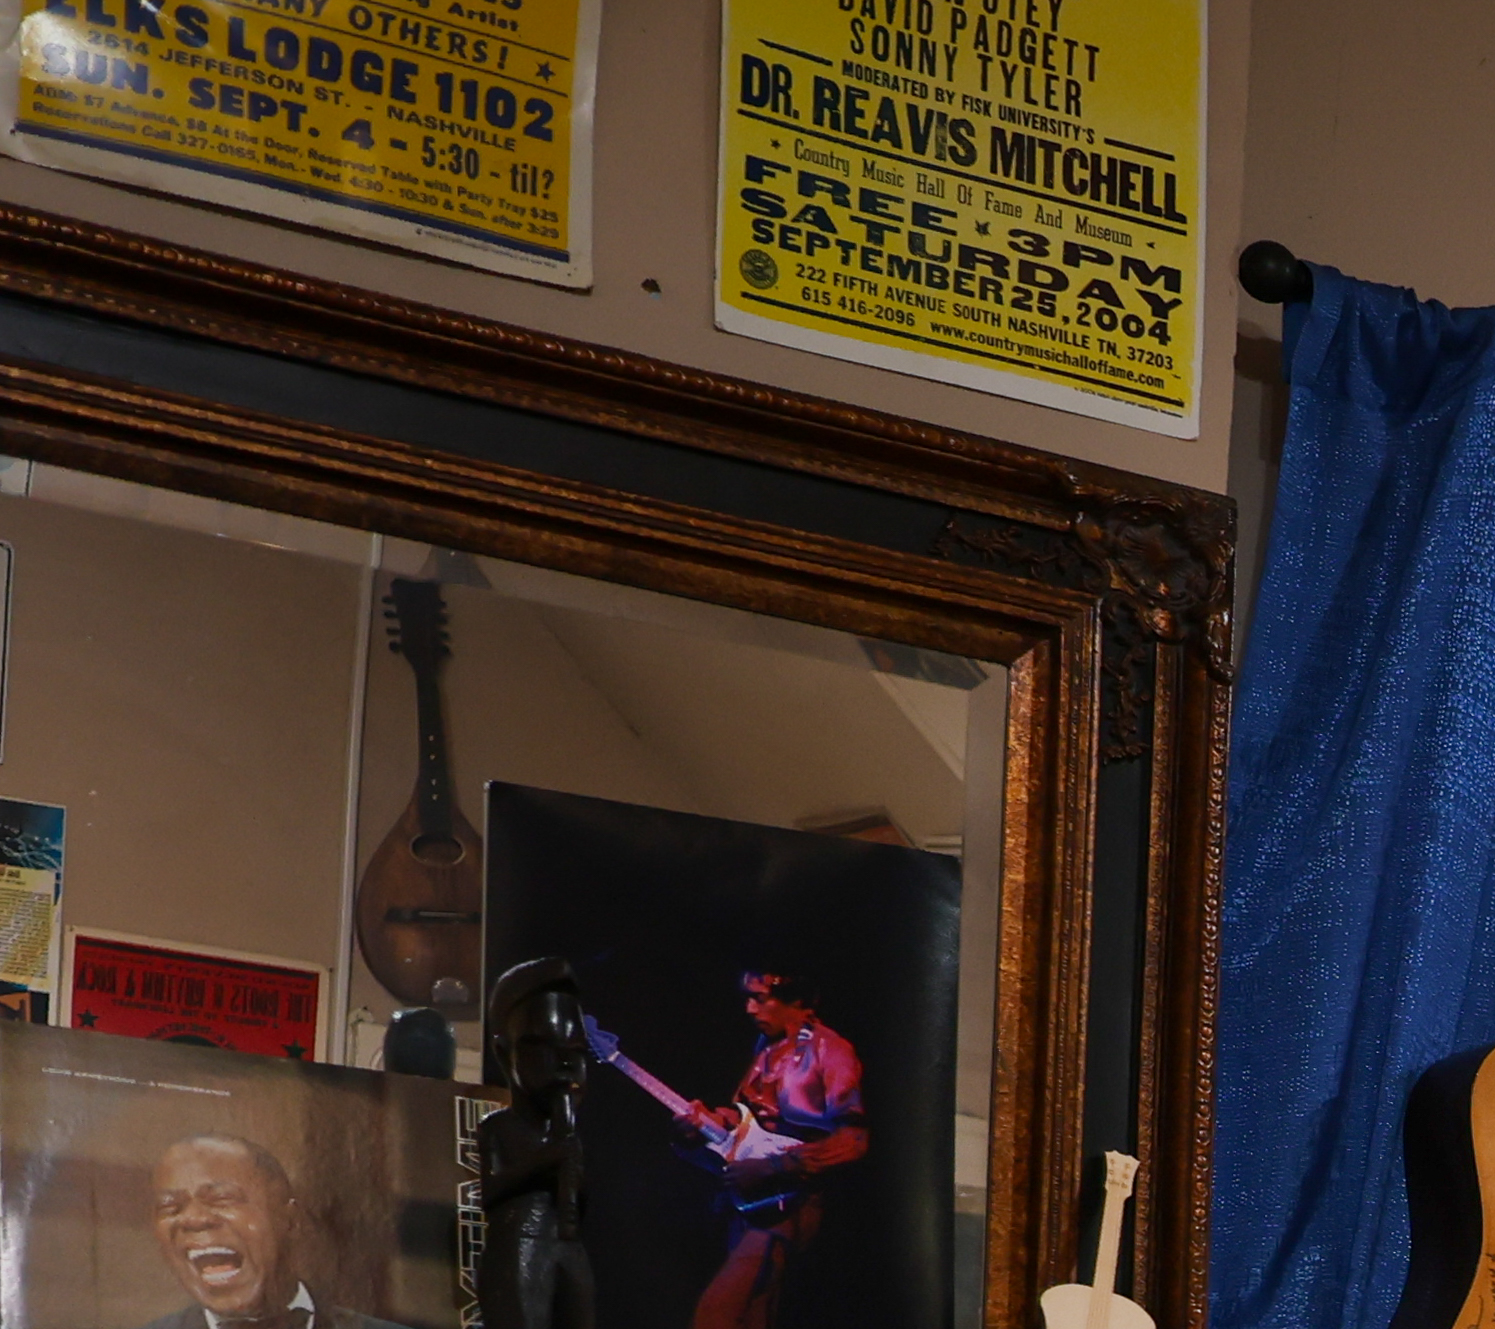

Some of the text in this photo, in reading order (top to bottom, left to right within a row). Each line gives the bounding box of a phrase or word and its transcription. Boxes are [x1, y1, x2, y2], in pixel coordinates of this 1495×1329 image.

[348, 5, 509, 71] OTHERS!
[448, 4, 519, 32] Artist
[849, 16, 1083, 118] SONNY TYLER
[950, 7, 1101, 82] PADGETT
[41, 43, 165, 99] SUN.
[188, 77, 321, 138] SEPT.
[342, 118, 375, 150] 4
[421, 135, 480, 181] 5:30
[510, 162, 556, 199] til?
[158, 48, 304, 96] JEFFERSON
[314, 86, 350, 109] ST.
[387, 105, 517, 152] NASHVILLE
[228, 16, 555, 142] LODGE 1102
[740, 52, 1189, 225] DR. REAVIS MITCHELL
[744, 154, 1184, 294] FREE 3PM
[794, 137, 1134, 248] Country Music Hall Of Fame And Museum
[740, 187, 1186, 321] SATURDAY
[751, 219, 1005, 307] SEPTEMBER
[801, 286, 833, 308] 615
[837, 292, 917, 328] 416-2096
